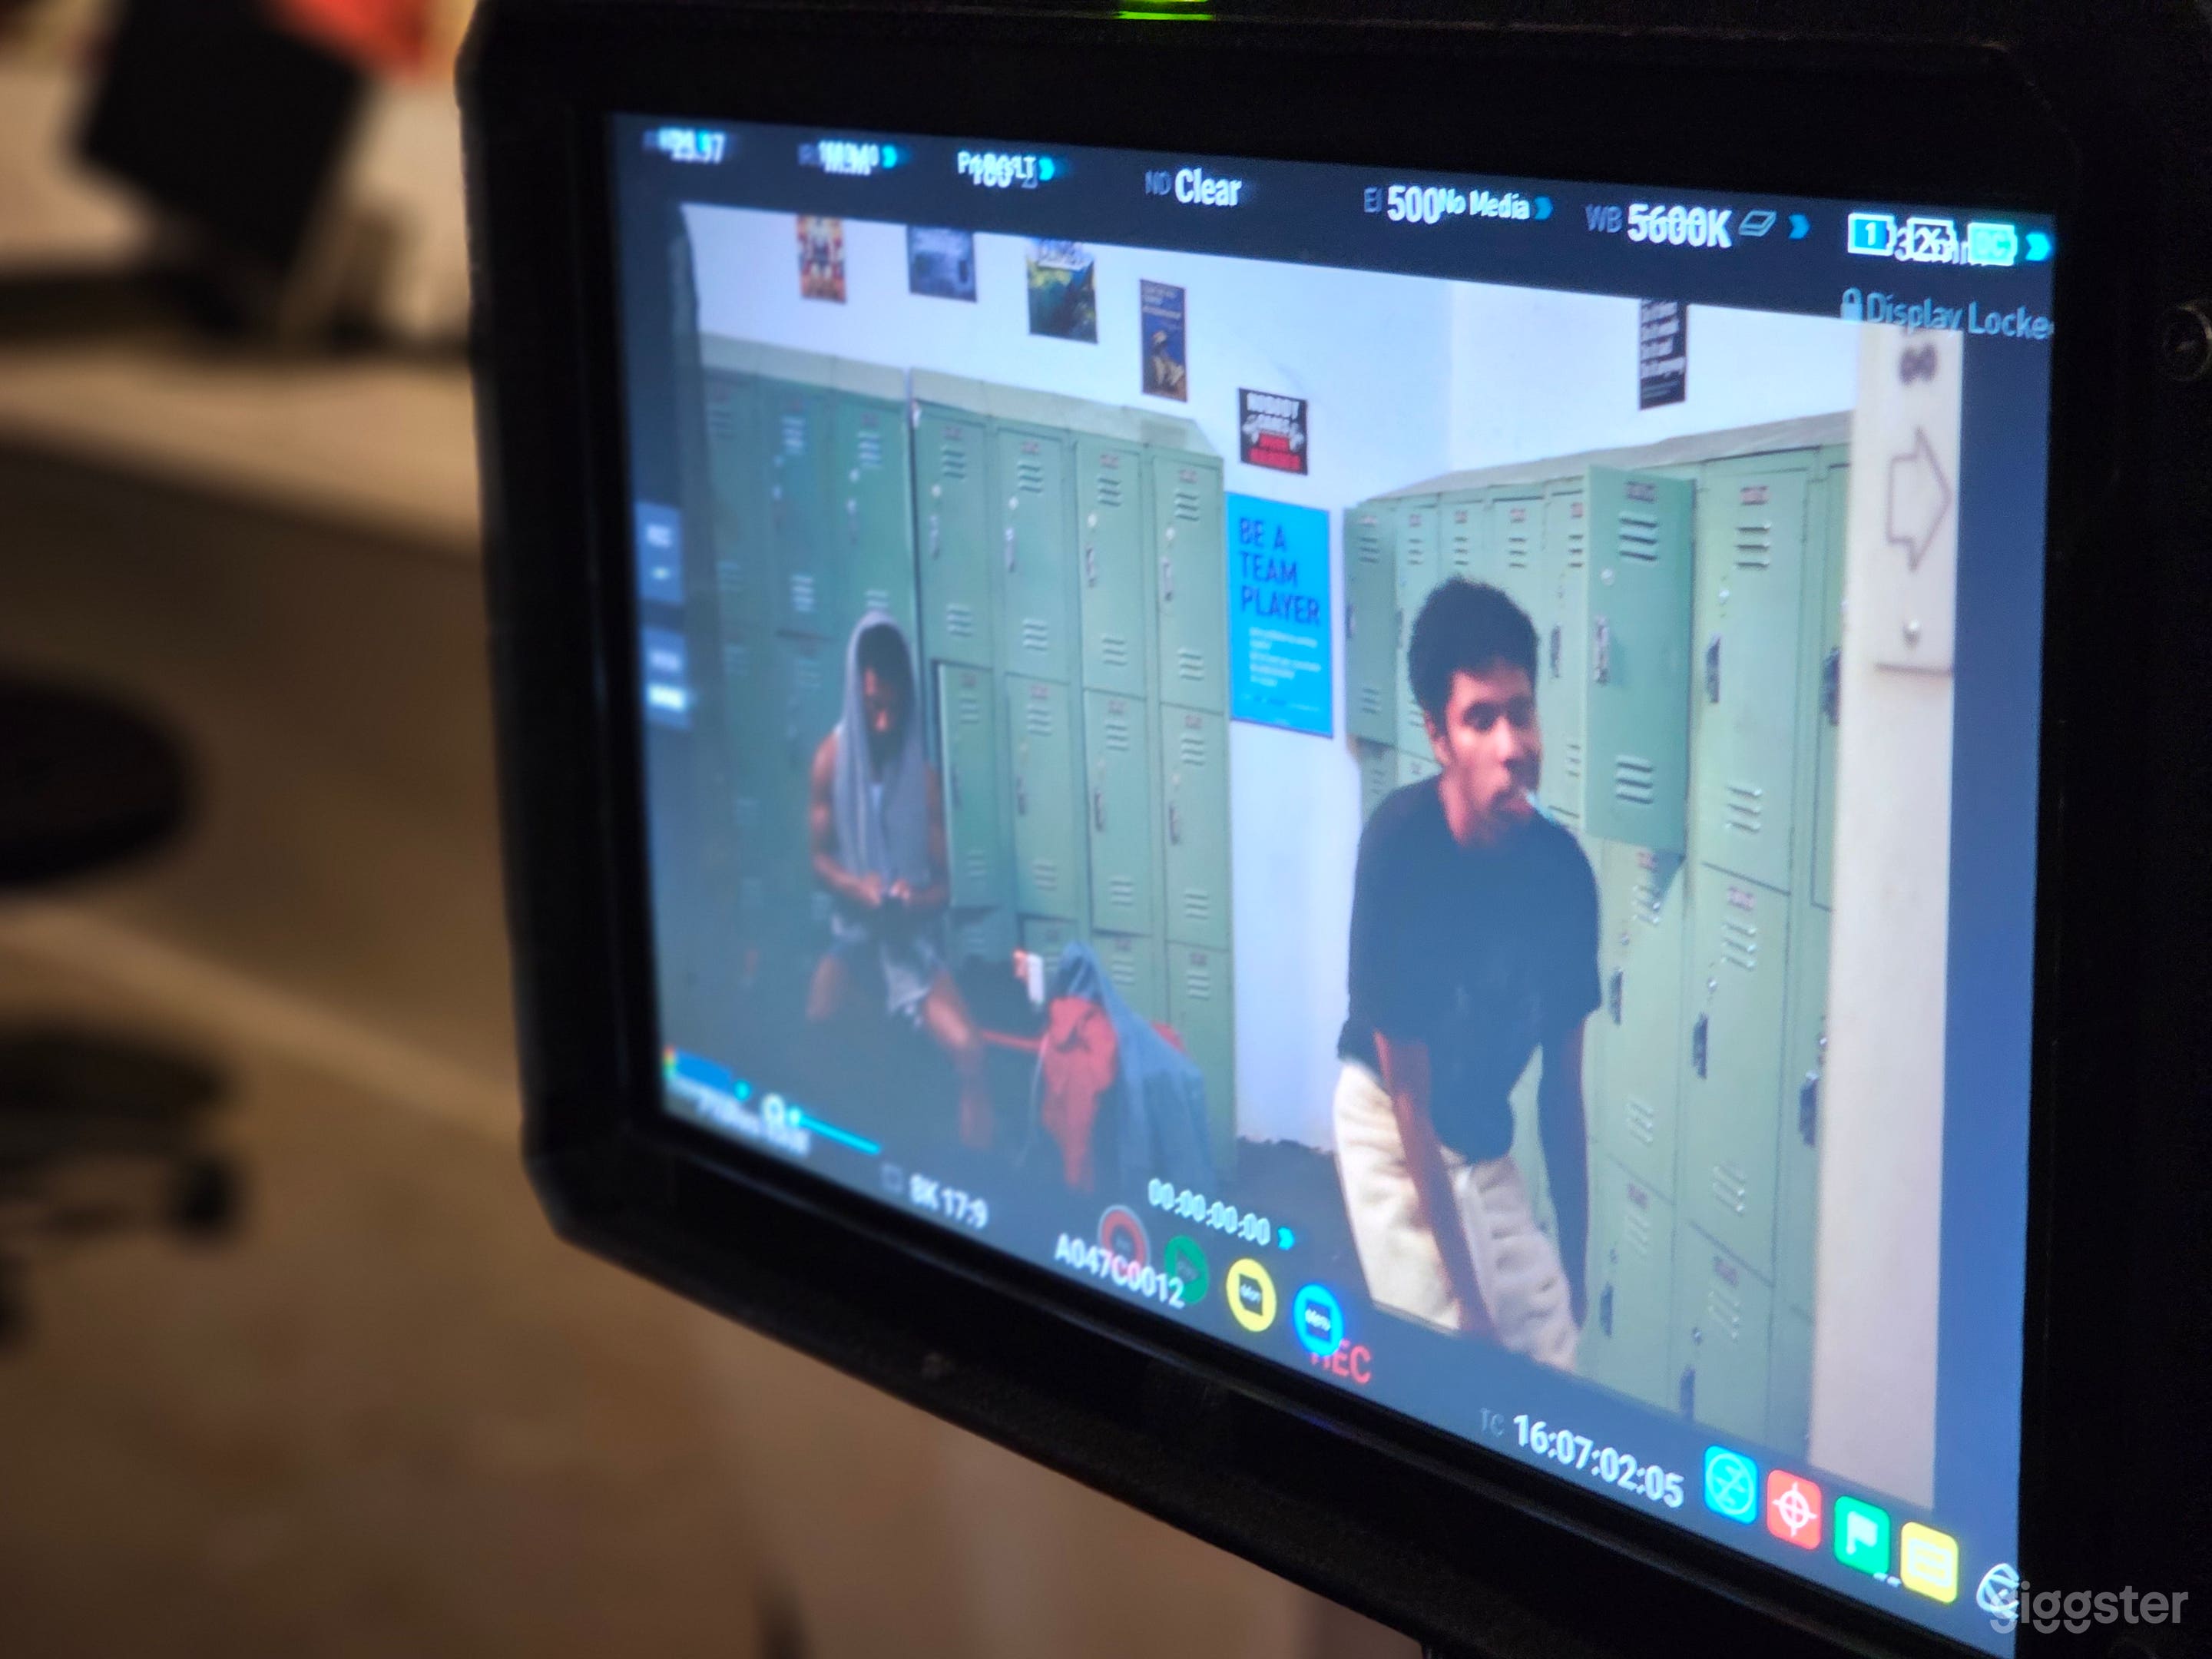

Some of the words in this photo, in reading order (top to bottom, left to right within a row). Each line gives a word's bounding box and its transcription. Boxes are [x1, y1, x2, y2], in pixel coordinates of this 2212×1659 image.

[1174, 167, 1242, 207] Clear
[1386, 184, 1442, 224] 500
[1469, 189, 1530, 220] Media
[1627, 203, 1733, 249] 5600K
[1866, 291, 1963, 336] Display
[1967, 300, 2055, 340] Locke
[1240, 517, 1264, 547] BE
[1273, 524, 1288, 552] A
[1239, 550, 1299, 588] TEAM
[1241, 584, 1320, 628] PLAYER
[1147, 1177, 1271, 1247] 00:00:00:00
[1055, 1232, 1186, 1310] A047C0012
[1512, 1414, 1685, 1508] 16:07:02:05
